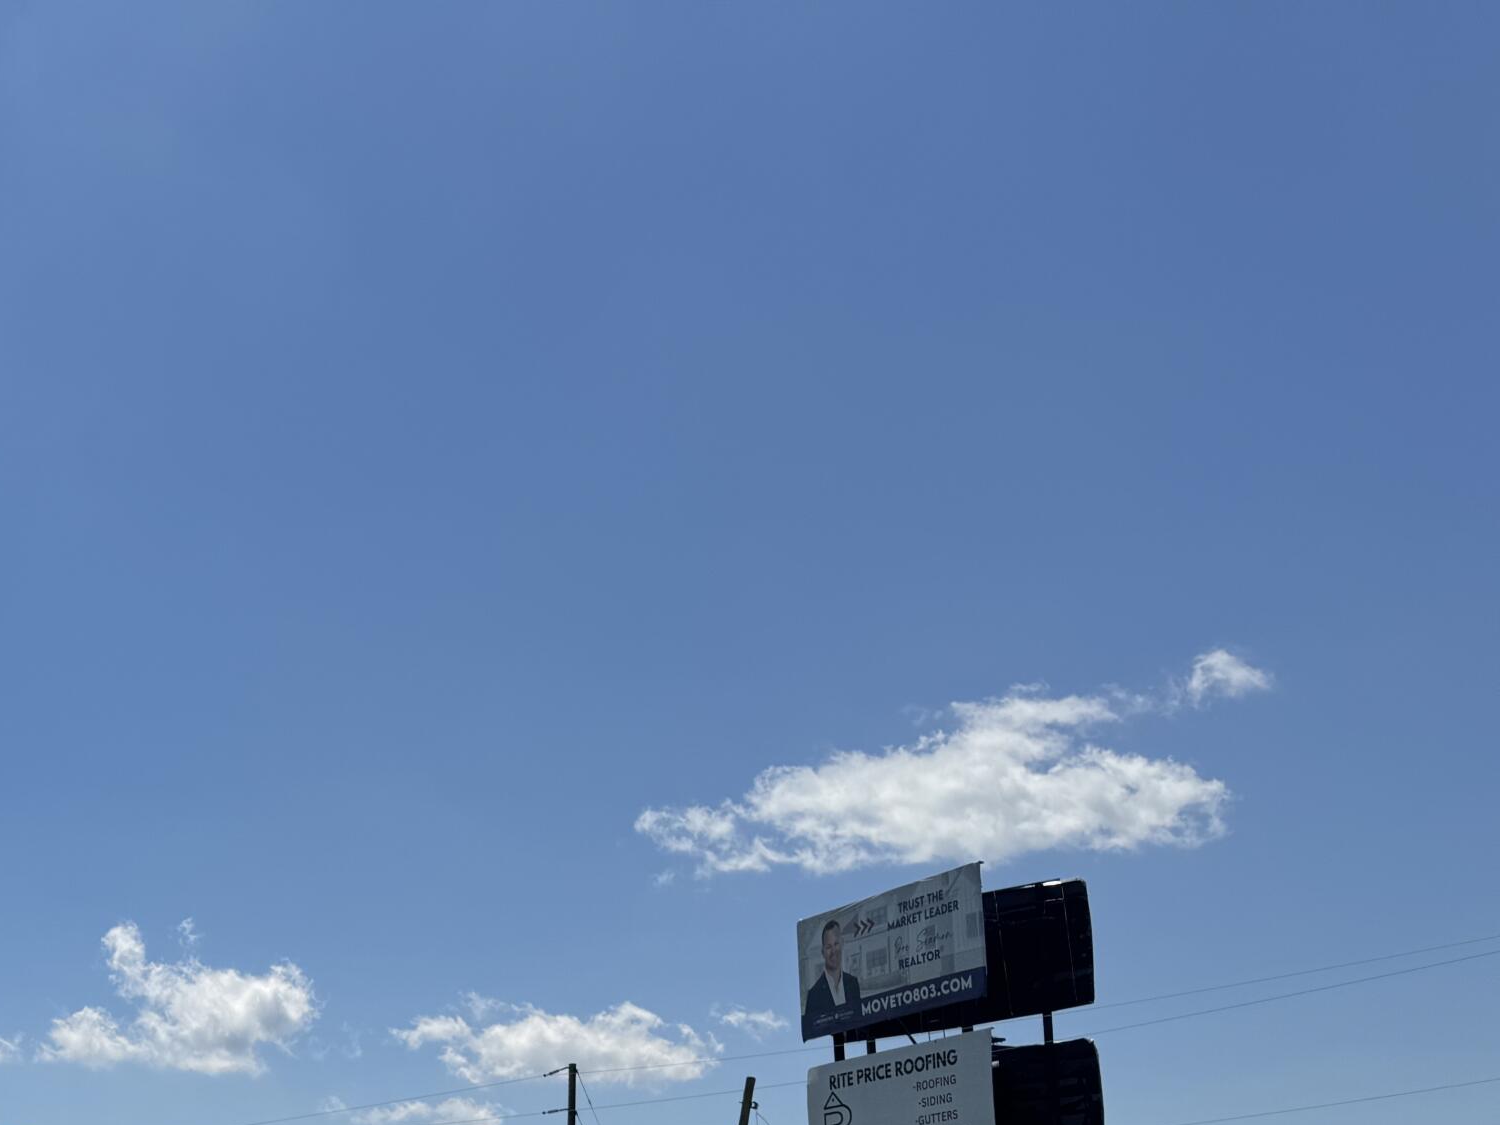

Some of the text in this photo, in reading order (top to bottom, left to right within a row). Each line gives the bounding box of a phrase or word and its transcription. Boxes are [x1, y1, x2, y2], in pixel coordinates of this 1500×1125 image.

[898, 889, 944, 914] TRUST THE
[887, 900, 959, 932] MARKET LEADER
[898, 949, 941, 970] REALTOR
[861, 975, 973, 1016] MOVETO803.COM
[829, 1049, 958, 1090] RITE PRICE ROOFING
[912, 1074, 957, 1092] -ROOFING
[918, 1092, 953, 1108] -SIDING
[915, 1109, 959, 1125] -GUTTERS
